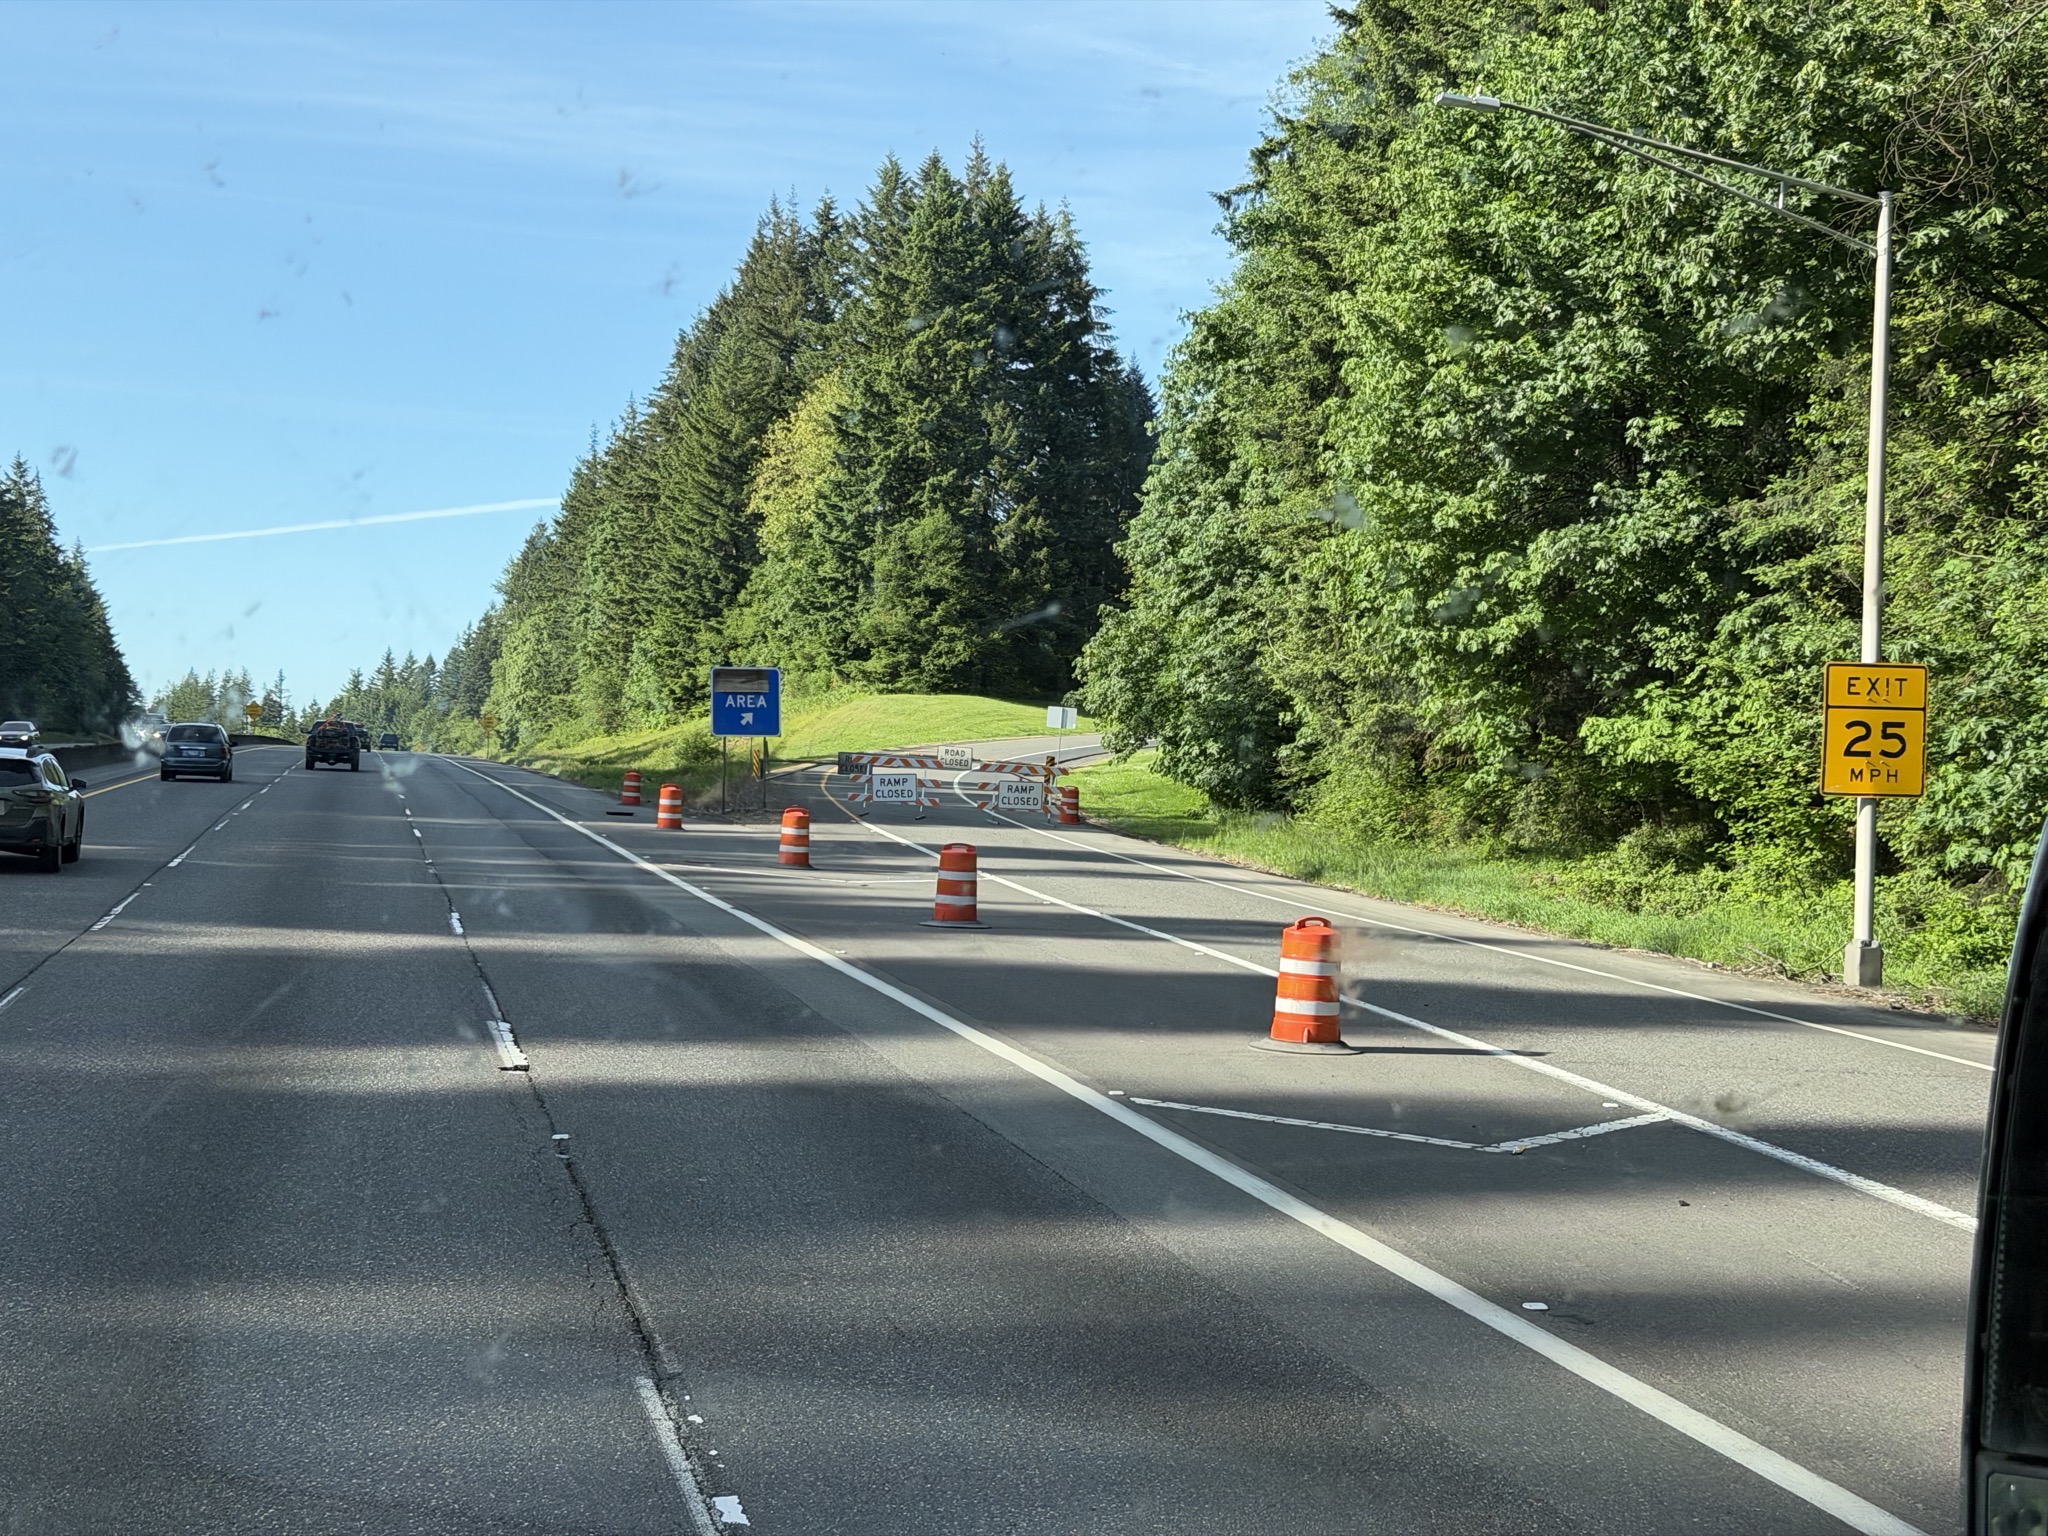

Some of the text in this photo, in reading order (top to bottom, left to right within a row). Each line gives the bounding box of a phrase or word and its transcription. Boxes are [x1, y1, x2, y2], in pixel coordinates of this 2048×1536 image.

[1847, 676, 1908, 697] EXIT
[725, 694, 767, 708] AREA
[1843, 720, 1907, 759] 25
[944, 748, 966, 757] ROAD
[940, 757, 969, 767] CLOSED
[841, 764, 867, 773] CLOSE
[1850, 768, 1898, 783] MPH
[880, 778, 908, 787] RAMP
[875, 789, 914, 799] CLOSED
[1007, 784, 1035, 794] RAMP
[1001, 796, 1039, 806] CLOSED
